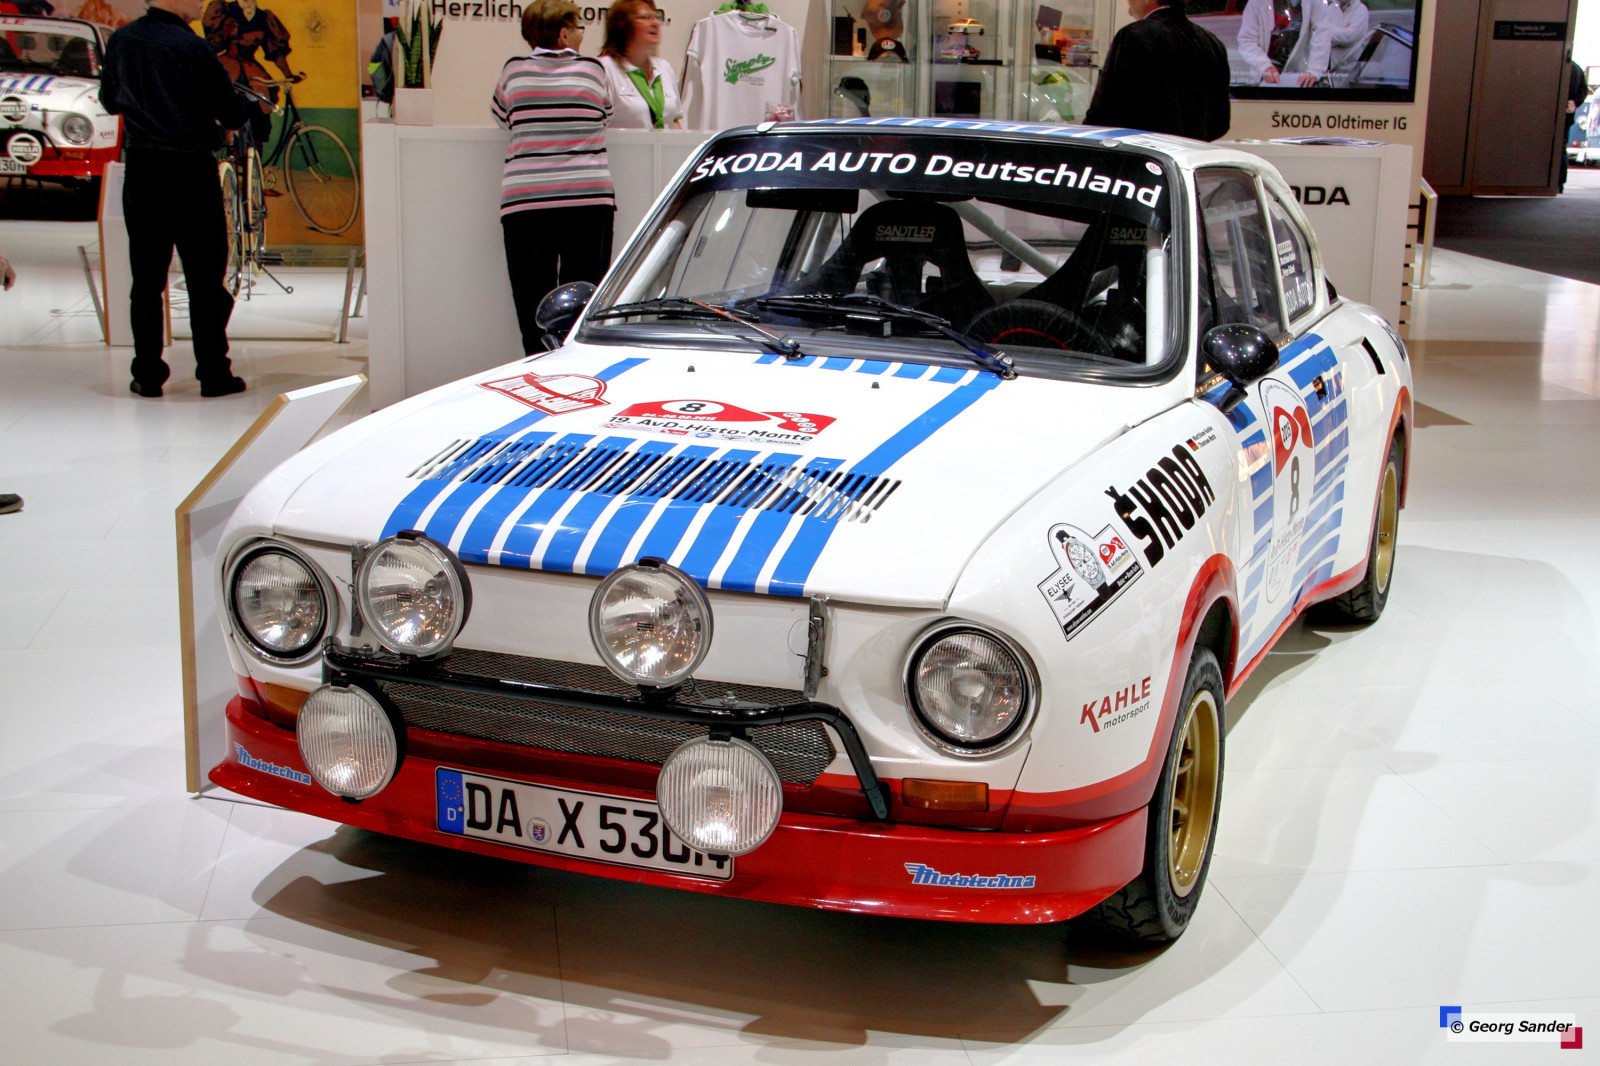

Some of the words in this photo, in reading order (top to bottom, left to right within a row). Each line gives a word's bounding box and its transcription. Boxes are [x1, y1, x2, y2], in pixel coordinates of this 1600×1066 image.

[431, 0, 522, 18] Herzlich
[1271, 111, 1321, 128] ŠKODA
[1326, 115, 1389, 130] Oldtimer
[1393, 117, 1407, 130] IG
[690, 153, 803, 182] ŠKODA
[810, 152, 917, 174] AUTO
[924, 154, 1162, 208] Deutschland
[679, 403, 706, 412] 8
[636, 419, 813, 442] AvD-Histo-Monte
[1287, 455, 1300, 526] 8
[1104, 444, 1216, 568] ŠKODA
[1047, 573, 1073, 598] ELYSEE
[1080, 676, 1151, 733] KAHLE
[1103, 701, 1150, 729] motorsport
[233, 741, 312, 786] Mototechna
[446, 807, 457, 821] D
[466, 782, 522, 838] DA
[557, 797, 585, 848] X
[600, 804, 727, 870] 530
[904, 862, 1036, 890] Mototechna
